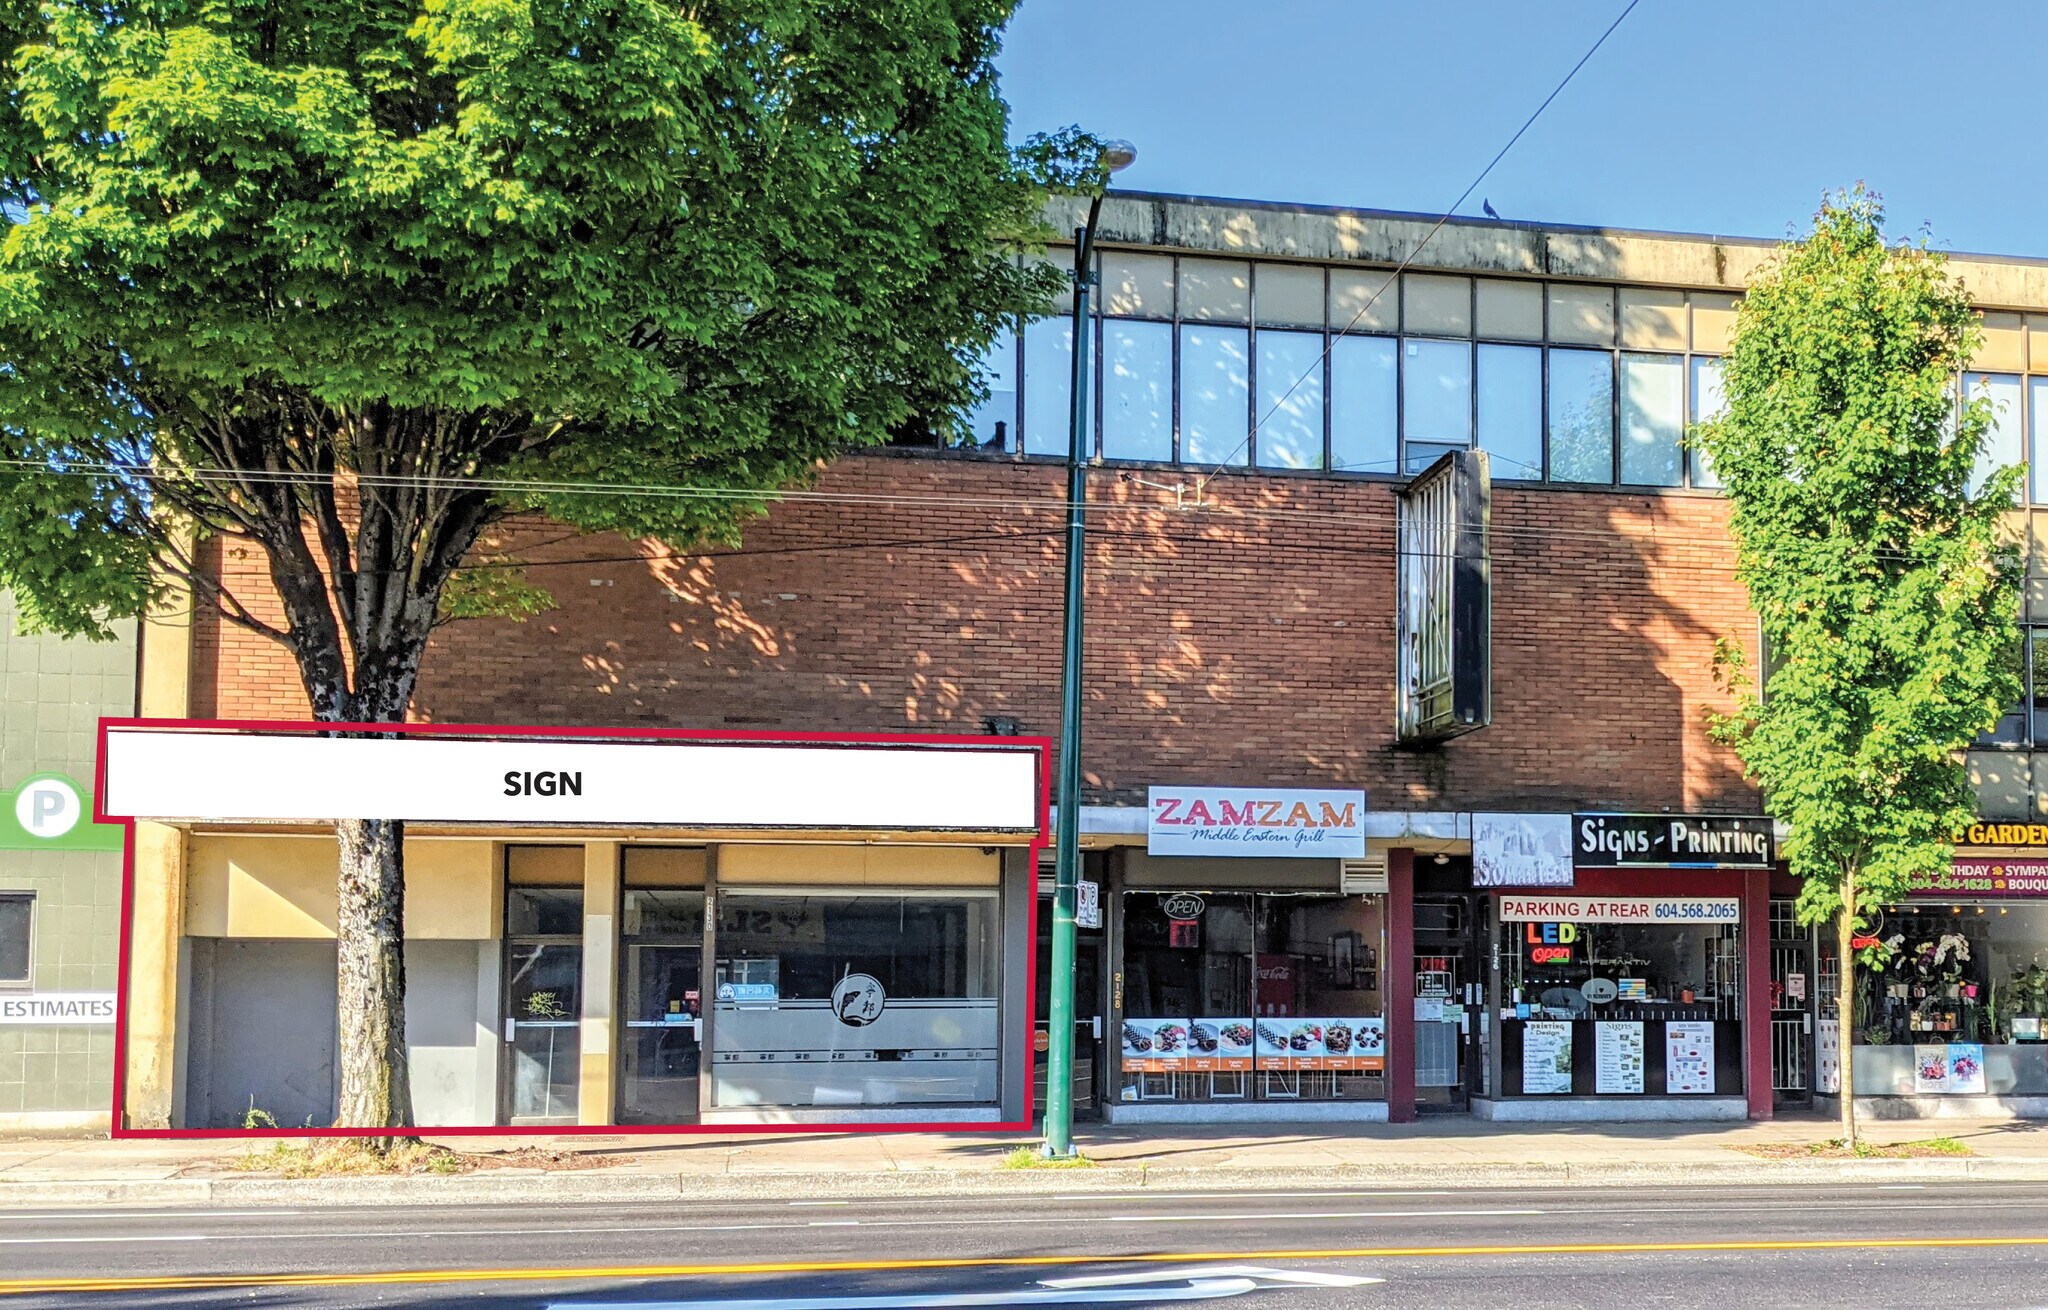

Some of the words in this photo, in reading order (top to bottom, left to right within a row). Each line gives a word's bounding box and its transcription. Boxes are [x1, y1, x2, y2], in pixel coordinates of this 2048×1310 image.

[32, 790, 65, 827] P
[1155, 798, 1356, 828] ZAMZAM
[1190, 828, 1240, 841] Middle
[1243, 828, 1290, 842] Eastern
[1294, 829, 1325, 848] Grill
[1166, 900, 1200, 913] OPEN
[1504, 902, 1580, 916] PARKING
[1587, 904, 1607, 917] AT
[1610, 904, 1649, 917] REAR
[1655, 903, 1737, 918] 604.568.2065
[1527, 923, 1576, 943] LED
[1532, 947, 1570, 963] Open
[4, 1000, 113, 1017] ESTIMATES
[1606, 1022, 1633, 1031] Signs
